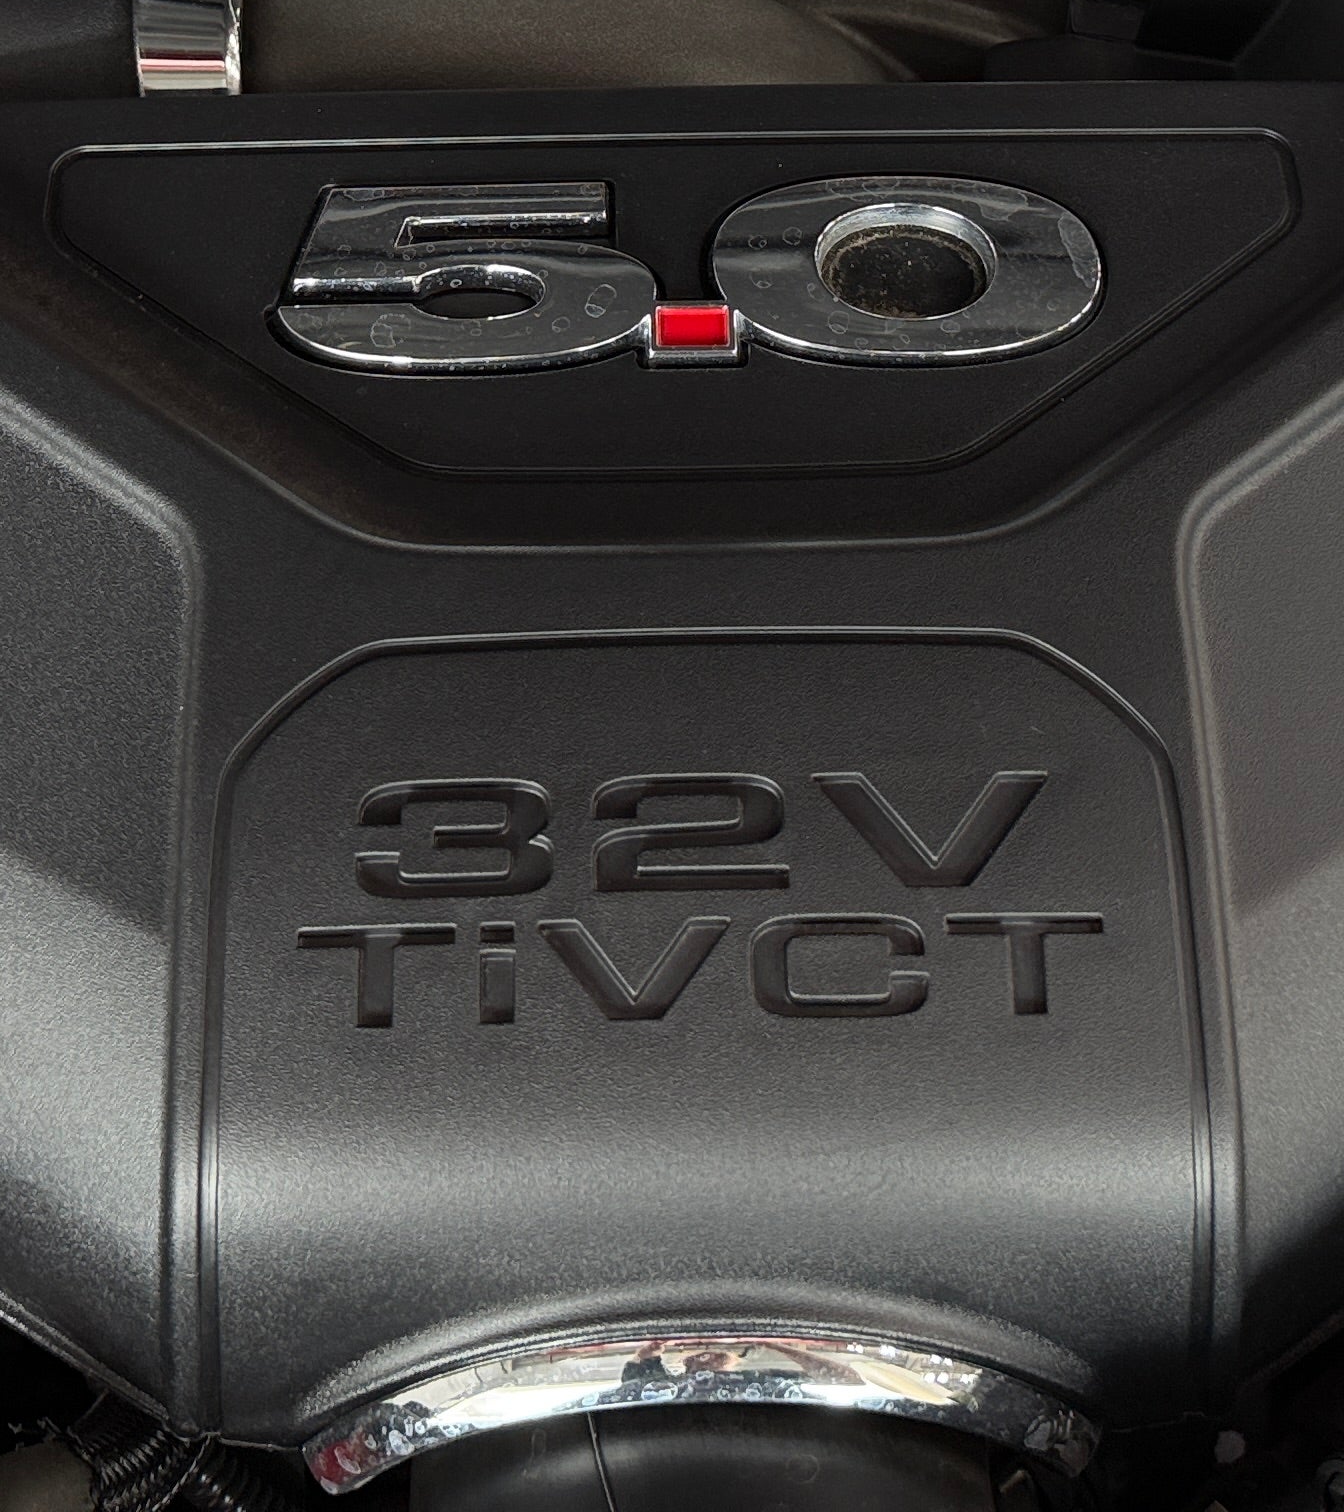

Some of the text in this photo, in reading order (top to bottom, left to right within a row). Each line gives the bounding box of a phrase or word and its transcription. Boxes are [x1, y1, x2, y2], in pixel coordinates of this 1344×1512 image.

[268, 175, 1106, 374] 5.0
[353, 771, 1049, 899] 32V
[296, 912, 1104, 1028] TiVCT
